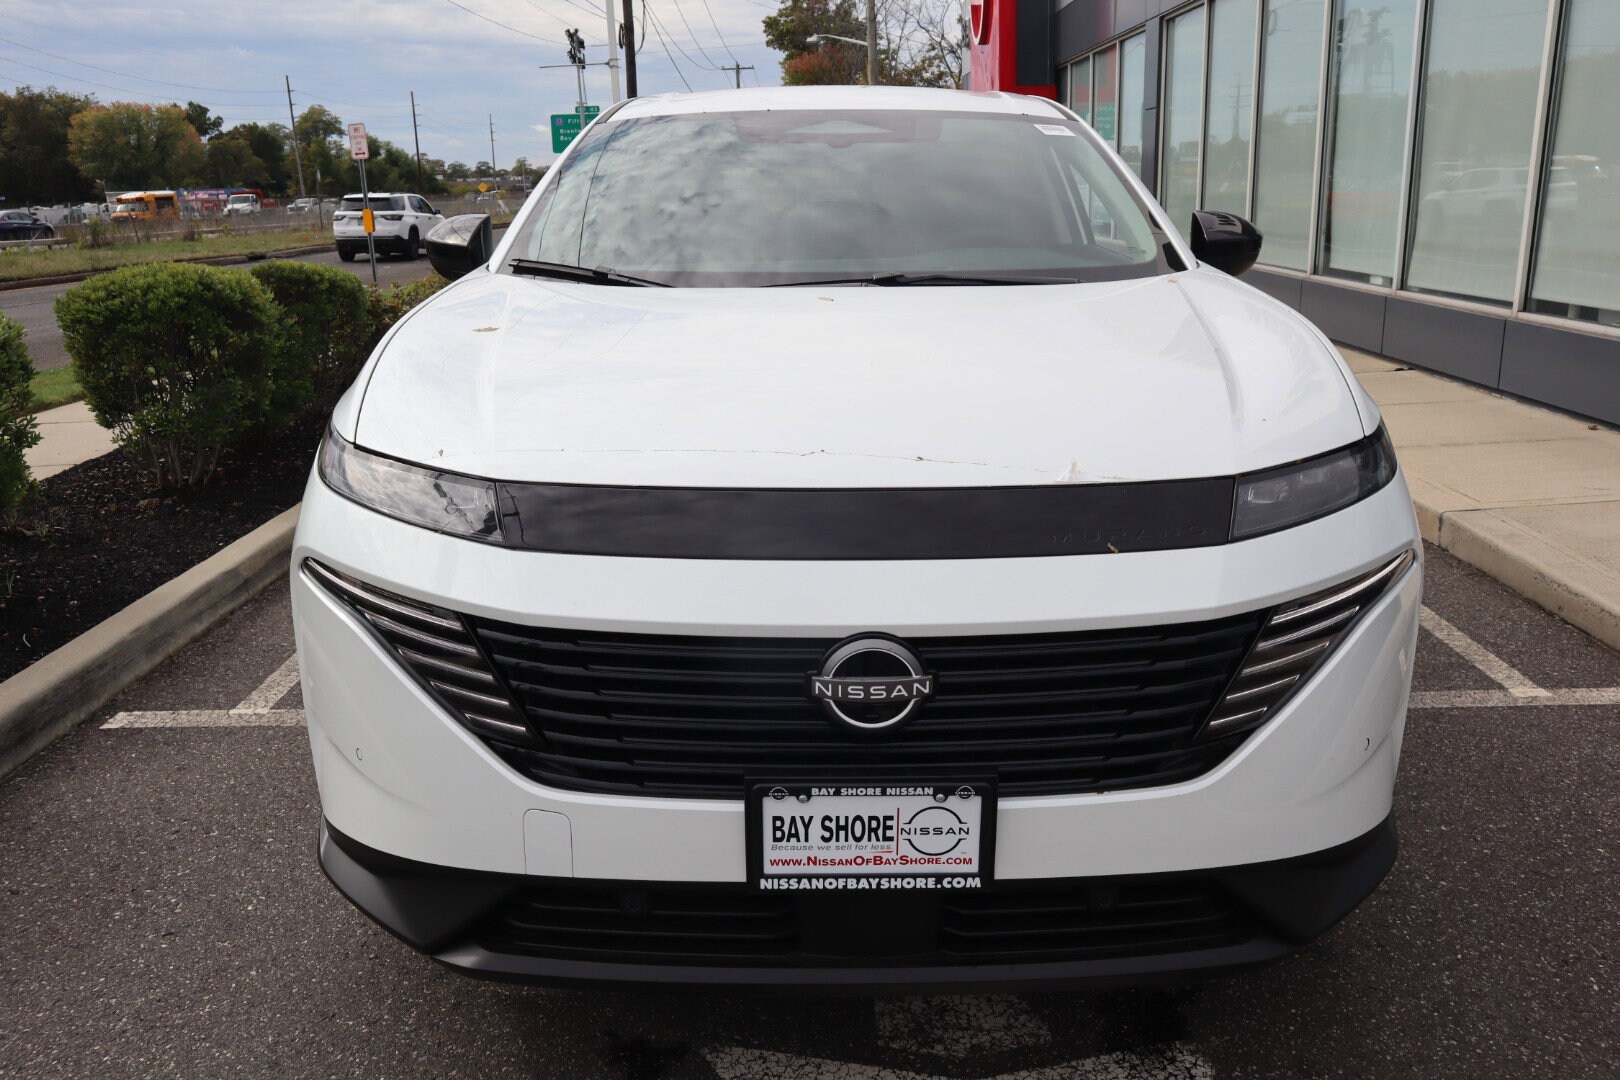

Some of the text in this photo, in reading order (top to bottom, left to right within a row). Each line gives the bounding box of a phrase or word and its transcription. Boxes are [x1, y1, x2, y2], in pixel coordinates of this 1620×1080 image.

[815, 680, 930, 699] NISSAN
[811, 787, 934, 796] BAY SHORE NISSAN
[772, 814, 895, 843] BAY SHORE
[900, 827, 970, 836] NISSAN
[835, 843, 853, 851] sell
[855, 843, 868, 851] for
[760, 877, 982, 889] NISSANOFBAYSHORE.COM
